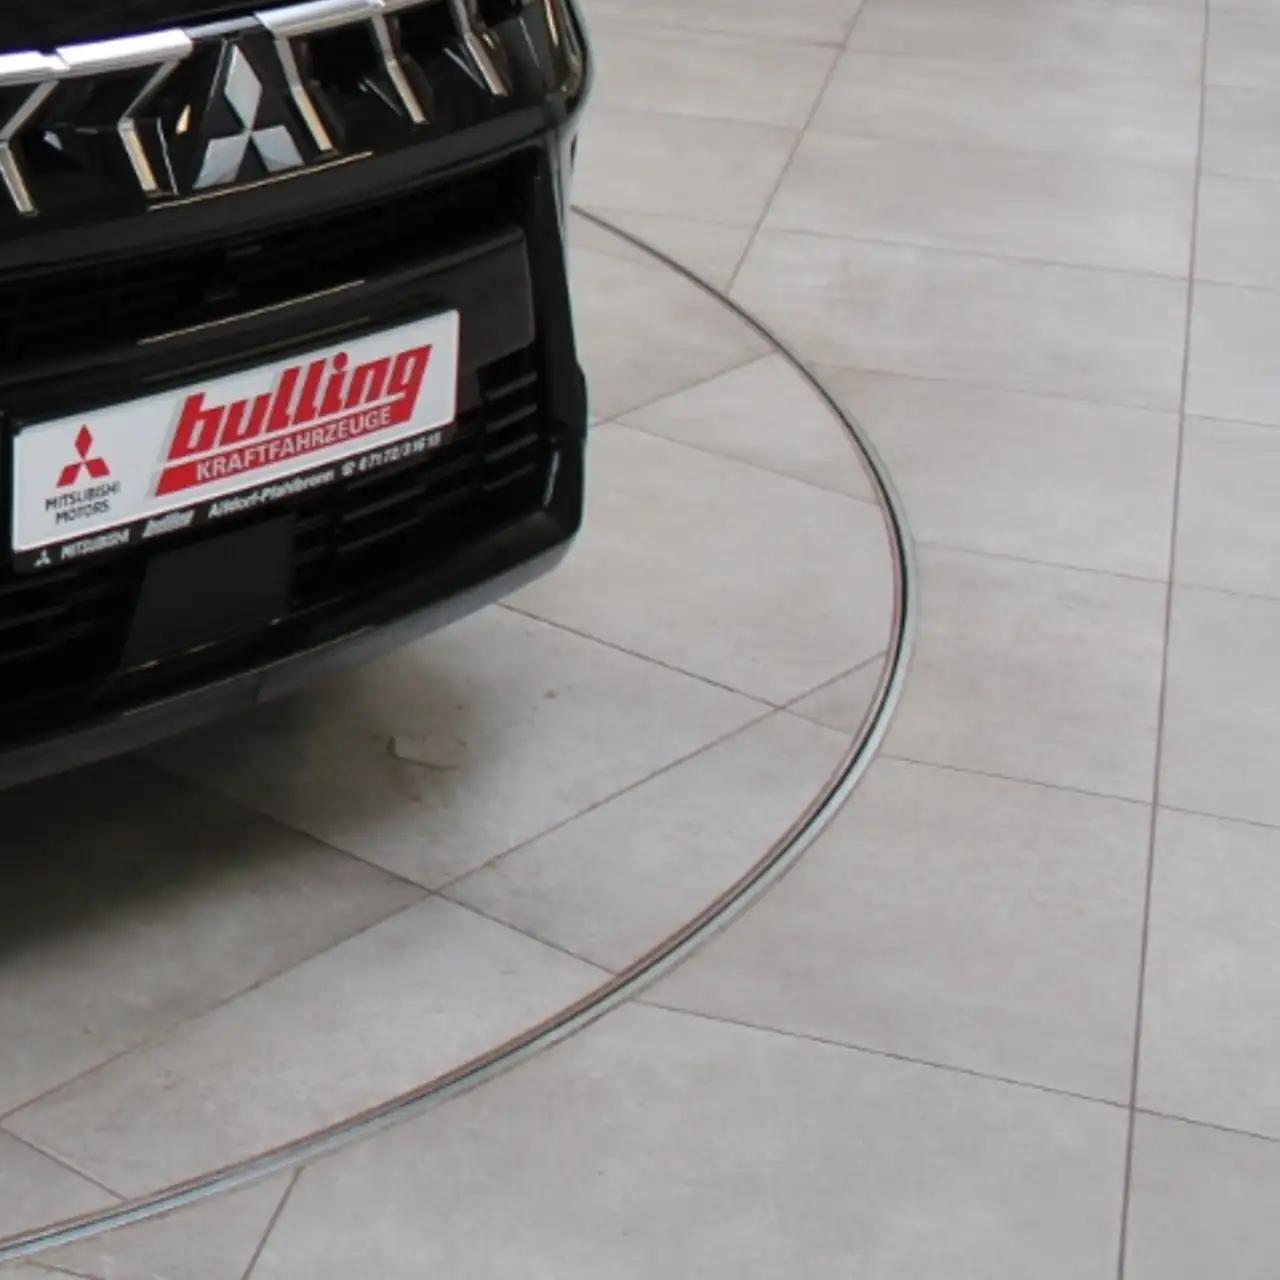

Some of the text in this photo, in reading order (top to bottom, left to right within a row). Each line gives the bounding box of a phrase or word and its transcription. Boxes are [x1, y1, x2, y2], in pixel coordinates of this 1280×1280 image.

[166, 344, 433, 462] bulling
[196, 406, 391, 481] KRAFTFAHRZEUGE
[45, 481, 122, 511] MITSUBISHI
[56, 499, 111, 524] MOTORS
